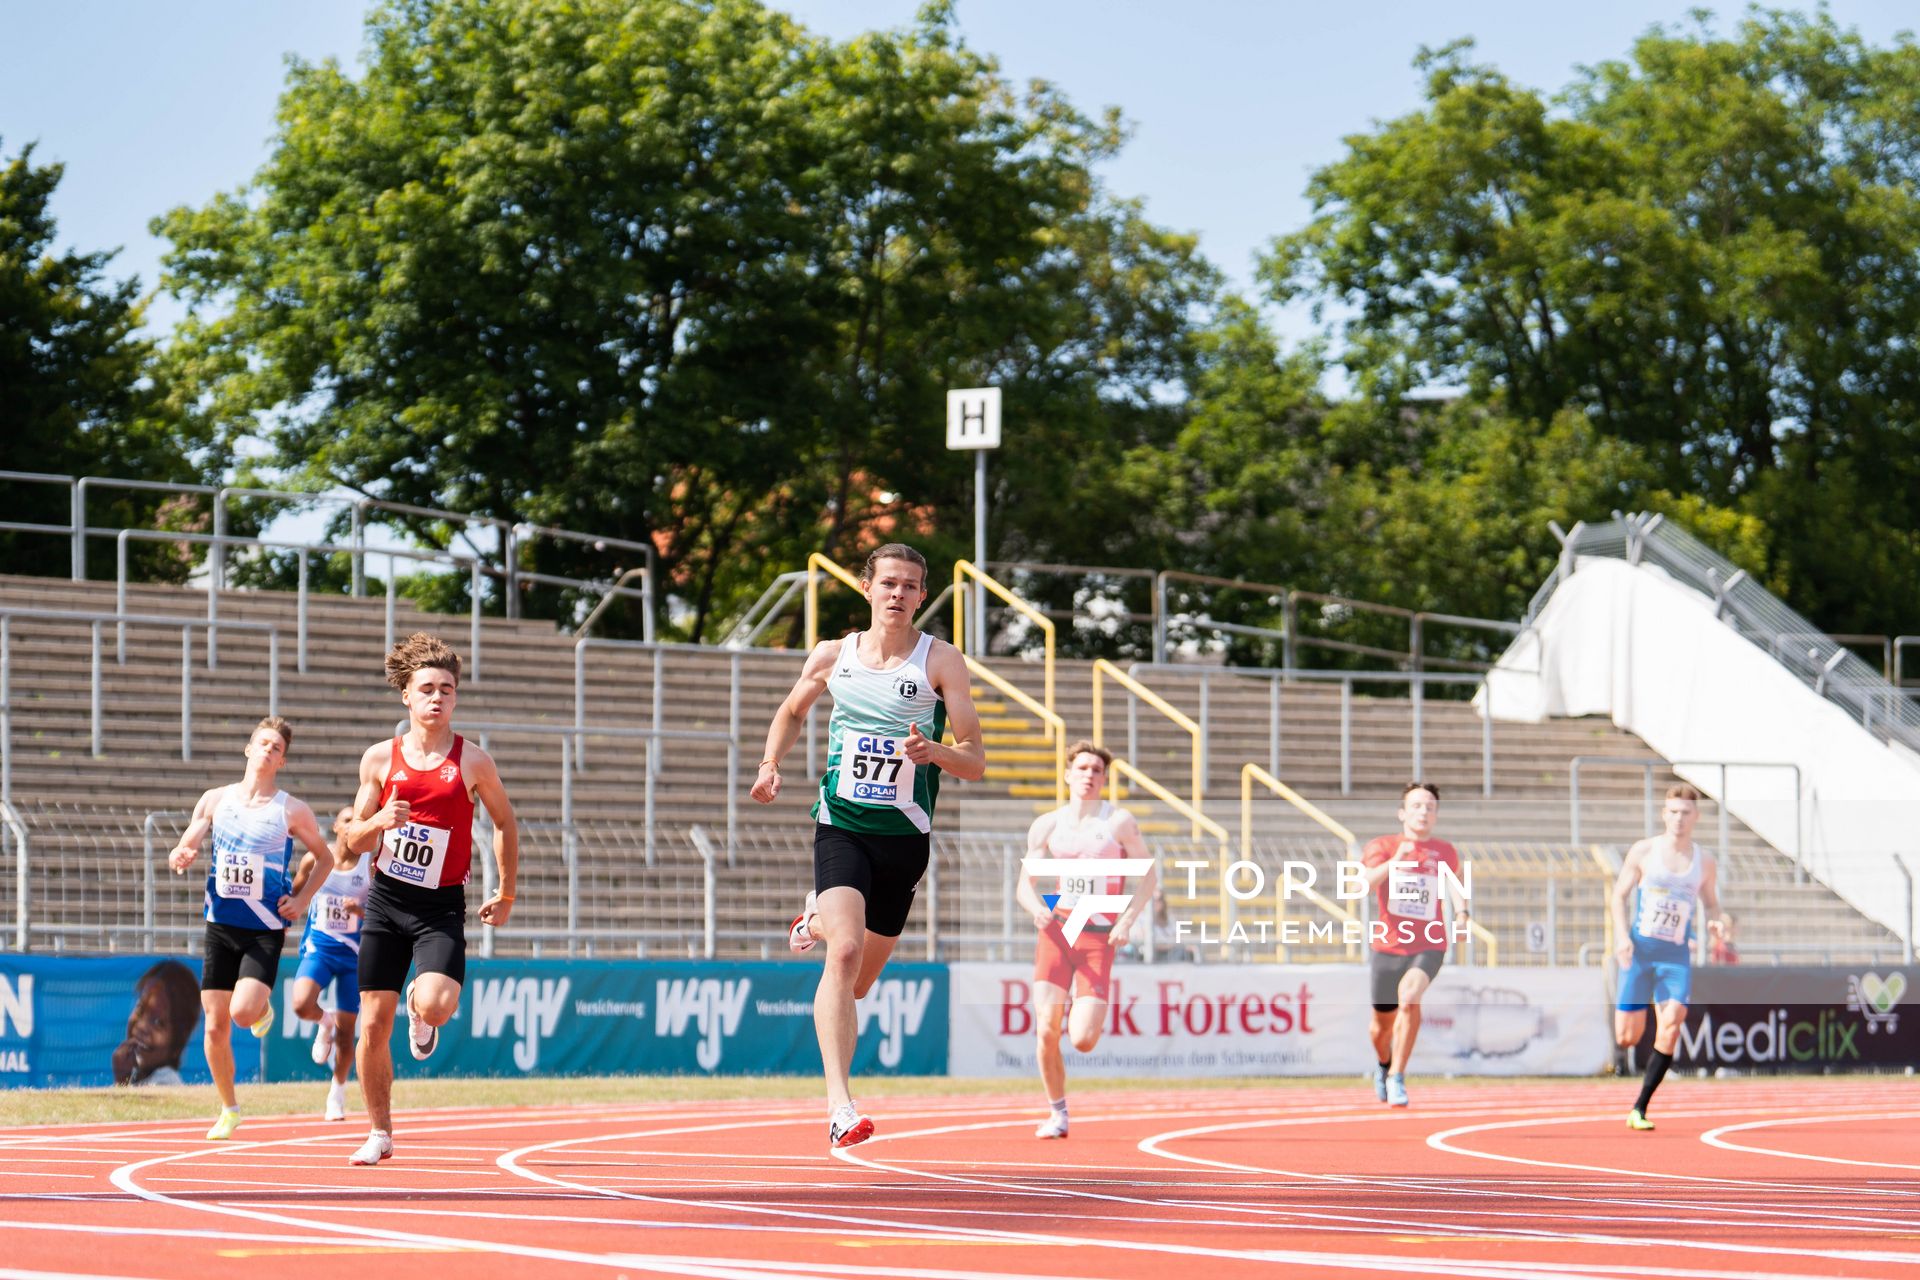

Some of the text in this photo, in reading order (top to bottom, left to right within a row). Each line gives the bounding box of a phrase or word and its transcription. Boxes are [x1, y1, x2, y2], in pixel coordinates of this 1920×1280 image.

[961, 400, 985, 436] H
[852, 754, 903, 783] 577
[871, 786, 896, 796] PLAN
[393, 837, 434, 867] 100
[222, 867, 254, 884] 418
[402, 865, 424, 879] PLAN
[1066, 878, 1095, 895] 991
[326, 907, 351, 921] 163
[1652, 911, 1681, 928] 779
[575, 999, 646, 1019] Versicherung
[756, 1000, 815, 1016] Versicheru
[1157, 979, 1314, 1036] Forest
[1673, 1009, 1861, 1062] Mediclix
